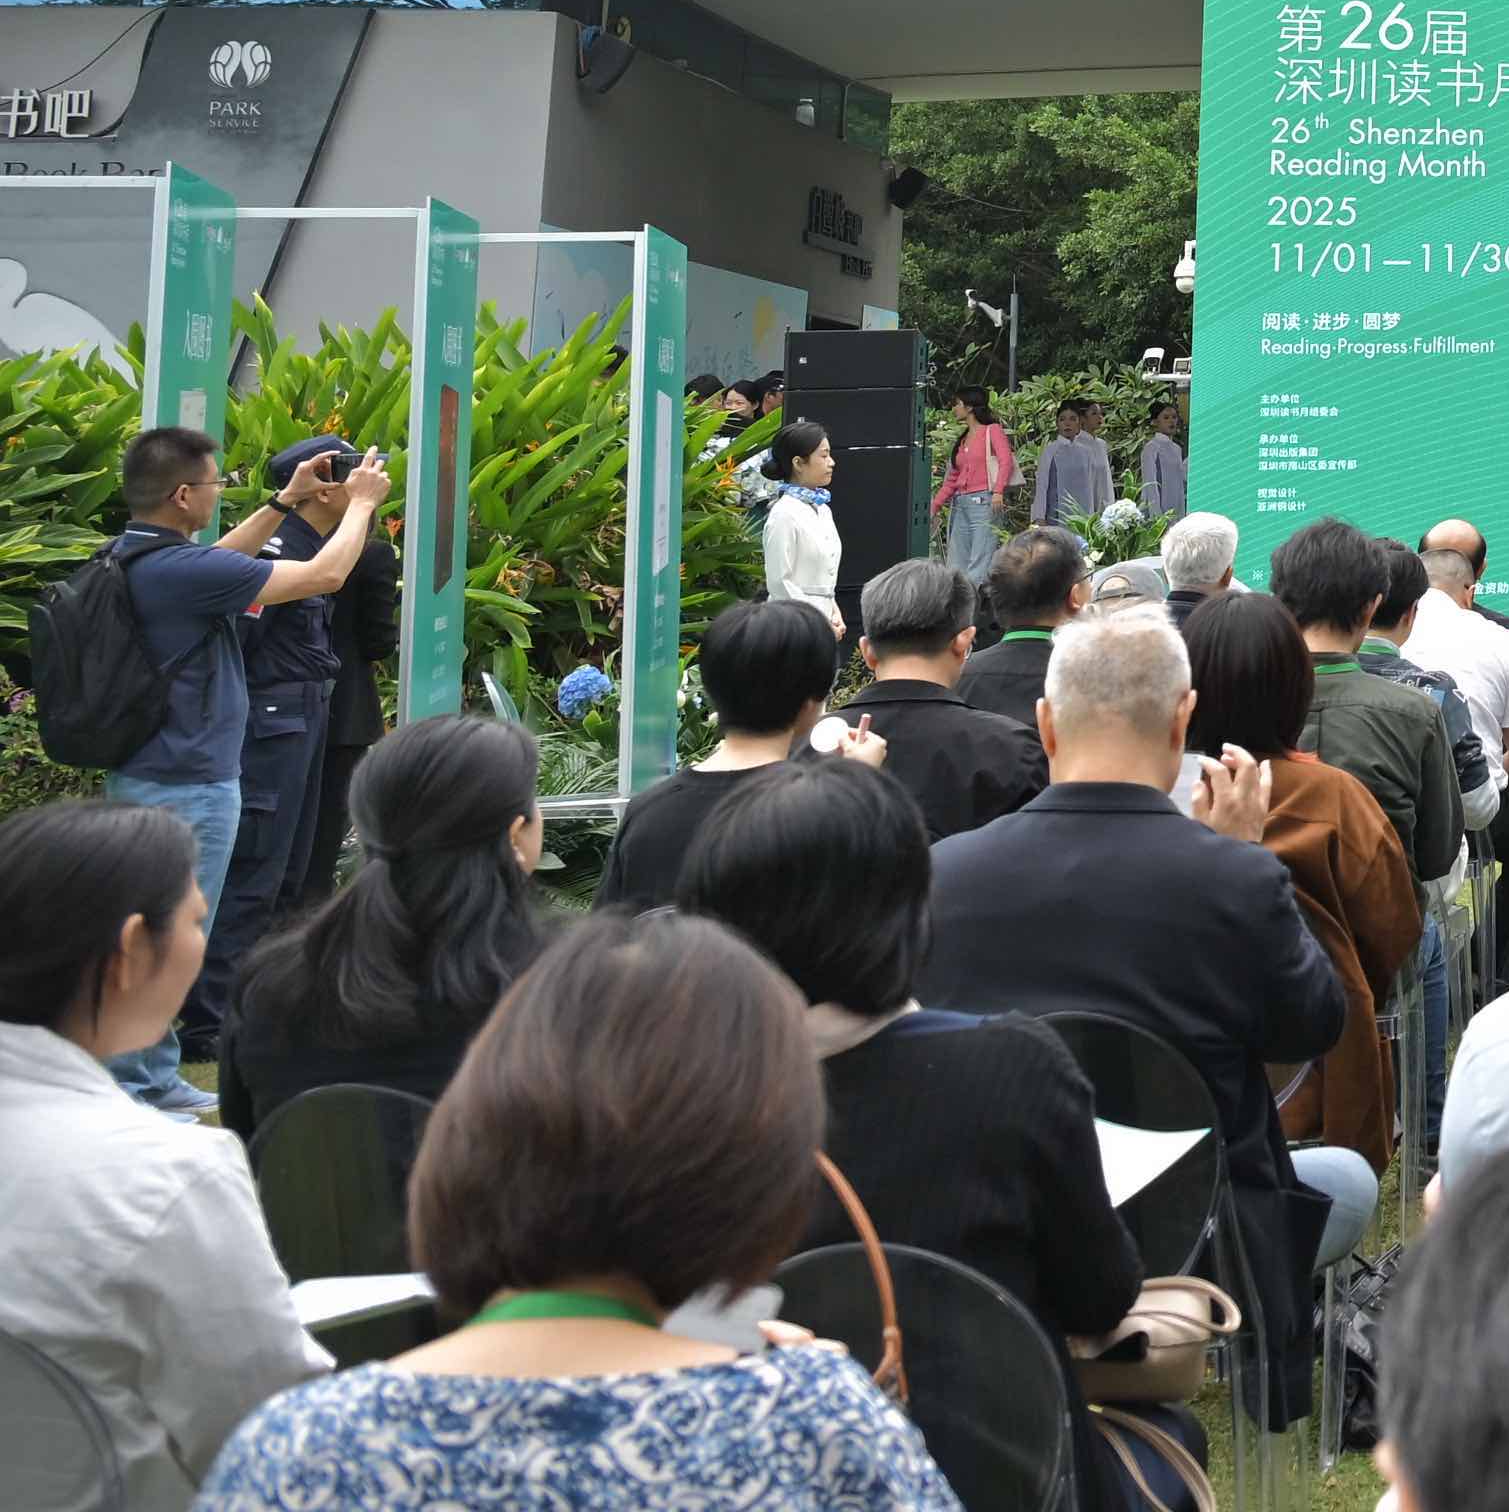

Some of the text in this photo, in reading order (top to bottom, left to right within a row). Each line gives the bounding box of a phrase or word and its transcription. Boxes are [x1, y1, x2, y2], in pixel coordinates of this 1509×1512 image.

[1276, 0, 1467, 56] 第26届
[210, 101, 261, 116] PARK
[1271, 113, 1484, 146] 26th Shenzhen
[1270, 148, 1486, 185] Reading Month
[1267, 196, 1357, 226] 2025
[1260, 394, 1300, 404] 主办单位
